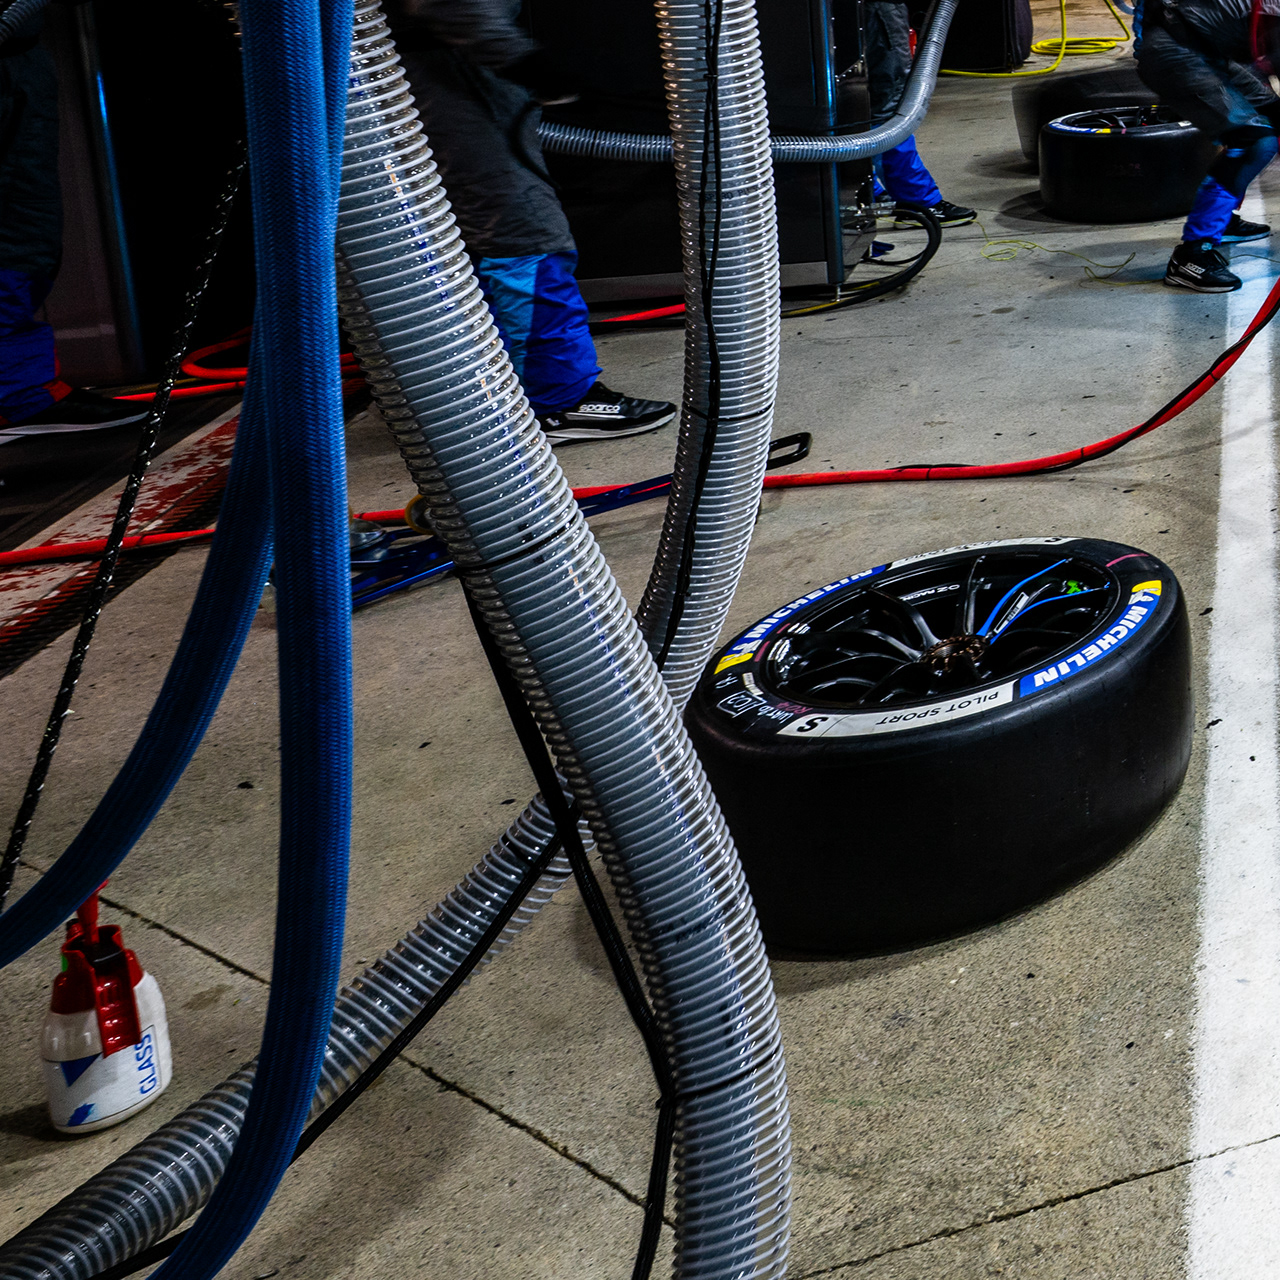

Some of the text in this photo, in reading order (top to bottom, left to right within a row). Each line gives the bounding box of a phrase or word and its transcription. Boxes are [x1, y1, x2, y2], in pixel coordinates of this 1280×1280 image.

[579, 404, 621, 413] sparco
[750, 567, 876, 641] MICHELIN
[1034, 605, 1149, 688] MICHELIN
[797, 716, 828, 733] S
[875, 690, 999, 726] PILOT SPORT
[134, 1033, 157, 1095] GLASS
